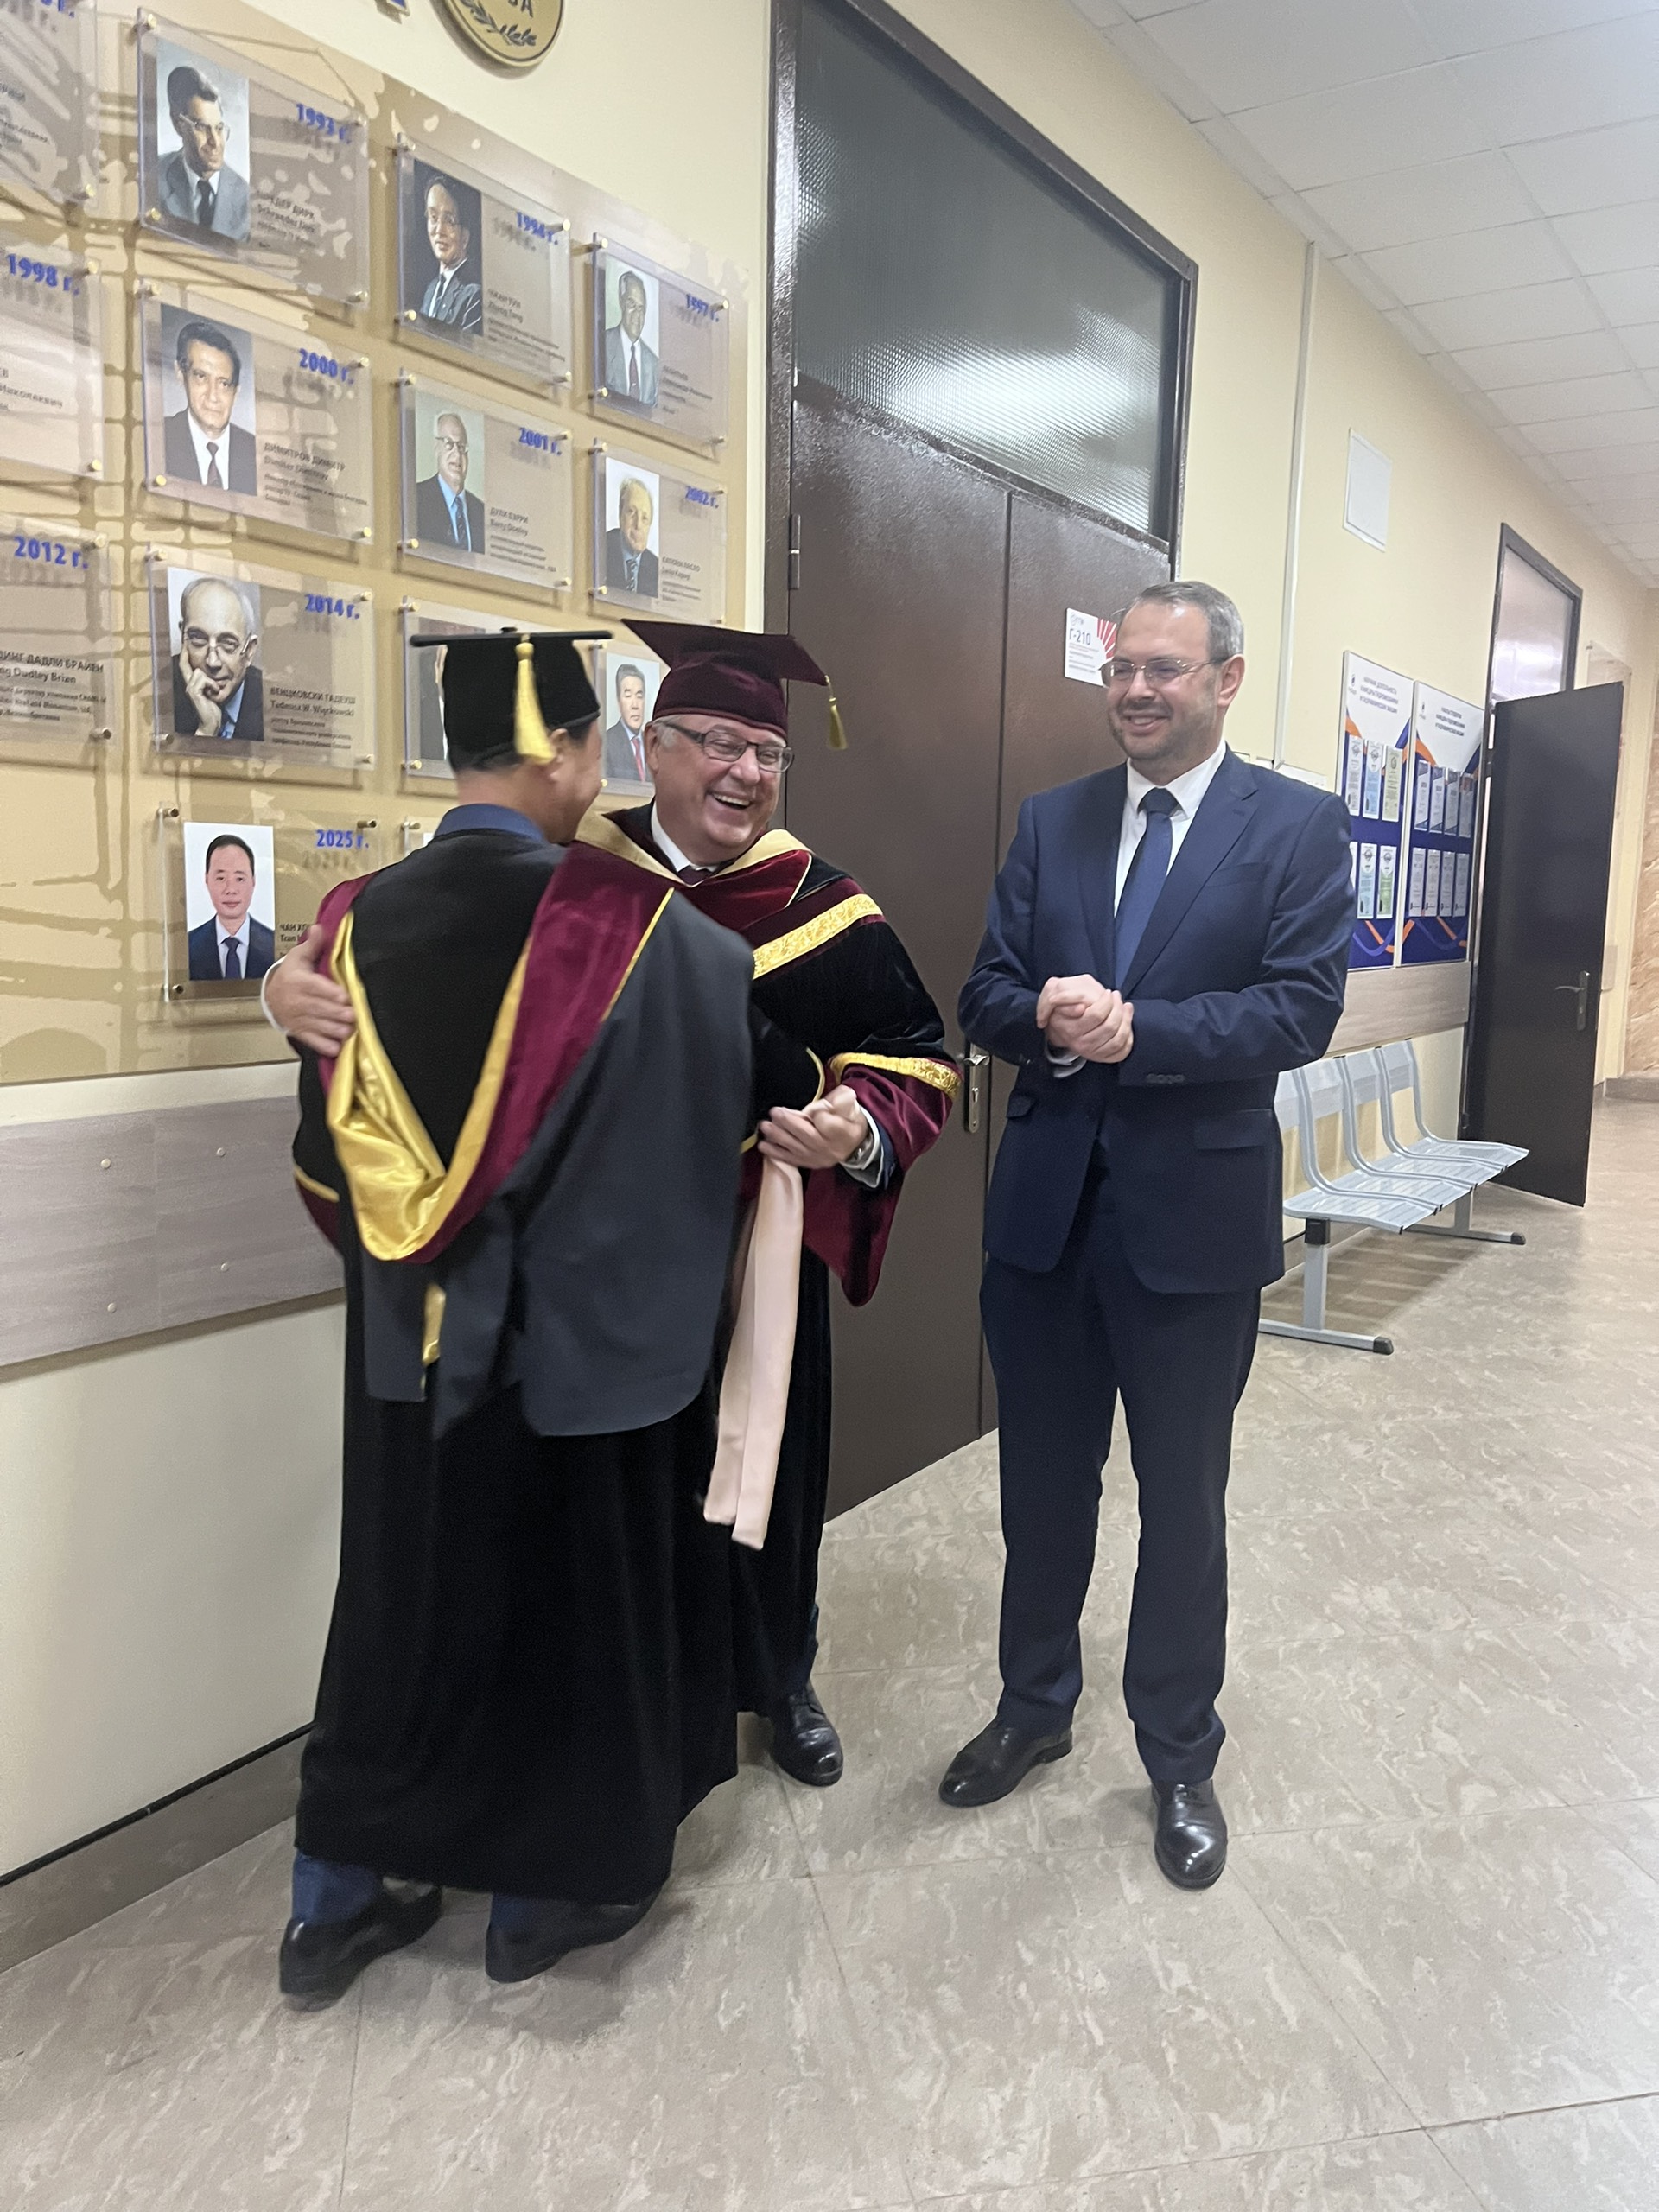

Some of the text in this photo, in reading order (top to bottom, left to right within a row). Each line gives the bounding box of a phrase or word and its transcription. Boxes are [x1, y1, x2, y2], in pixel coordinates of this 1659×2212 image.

[296, 103, 335, 137] 1993
[7, 253, 80, 296] 1998 г.
[299, 347, 354, 386] 2000 г.
[518, 427, 548, 451] 2001
[685, 485, 709, 505] 2002
[14, 536, 88, 569] 2012 г.
[304, 594, 360, 620] 2014 г.
[1069, 628, 1091, 646] Г-210
[26, 653, 63, 668] ДАДЛИ
[13, 667, 48, 683] Dudley
[316, 830, 370, 849] 2025 г.
